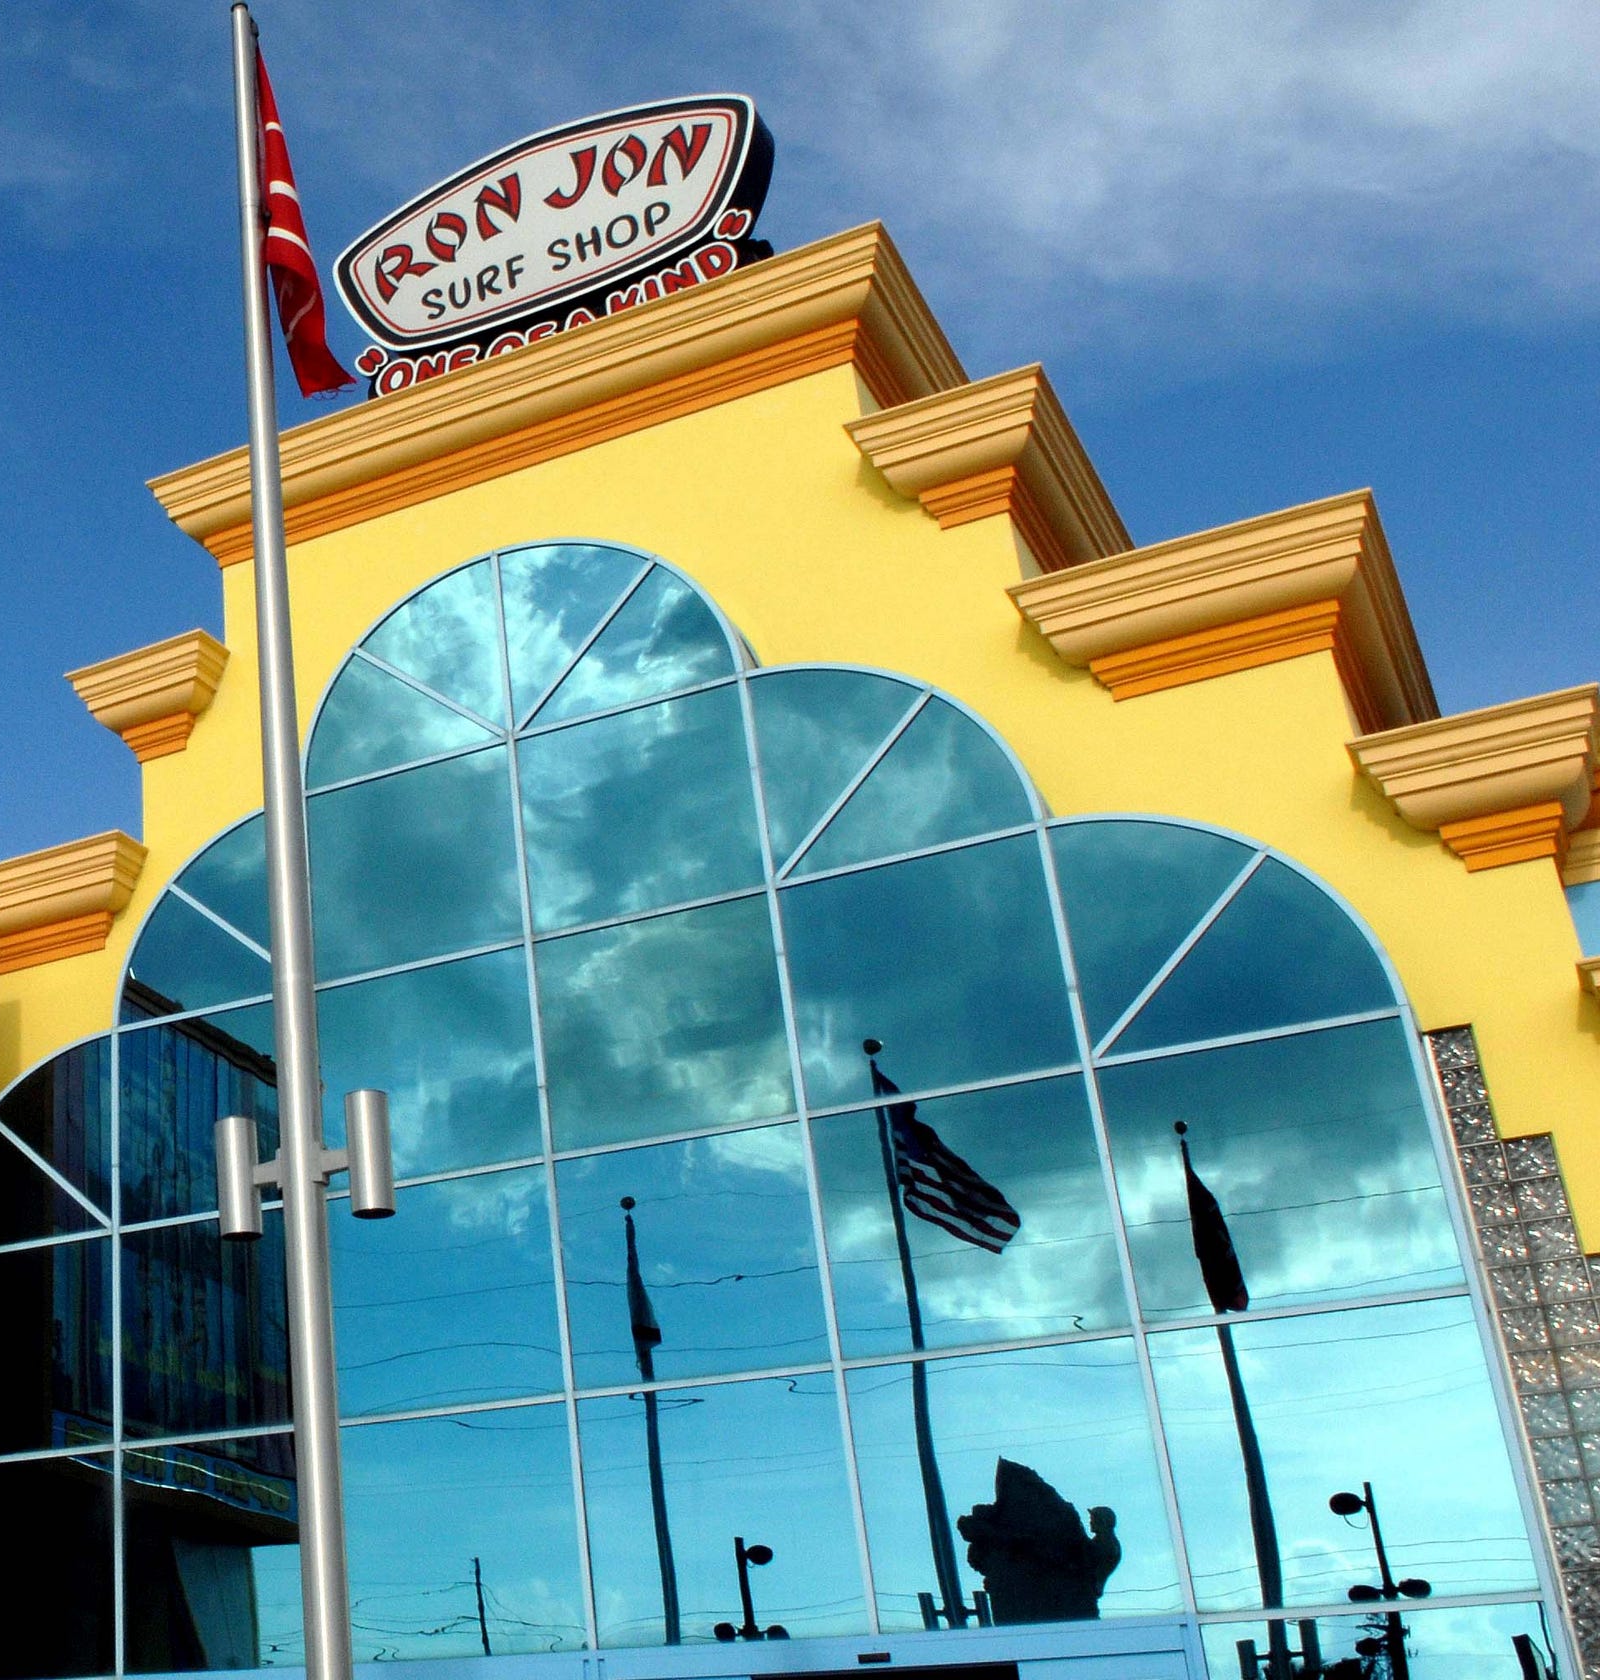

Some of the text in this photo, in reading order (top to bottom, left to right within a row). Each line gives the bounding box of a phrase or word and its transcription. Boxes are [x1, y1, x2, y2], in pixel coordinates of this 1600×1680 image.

[374, 122, 713, 305] RON JON
[421, 201, 672, 320] SURF SHOP
